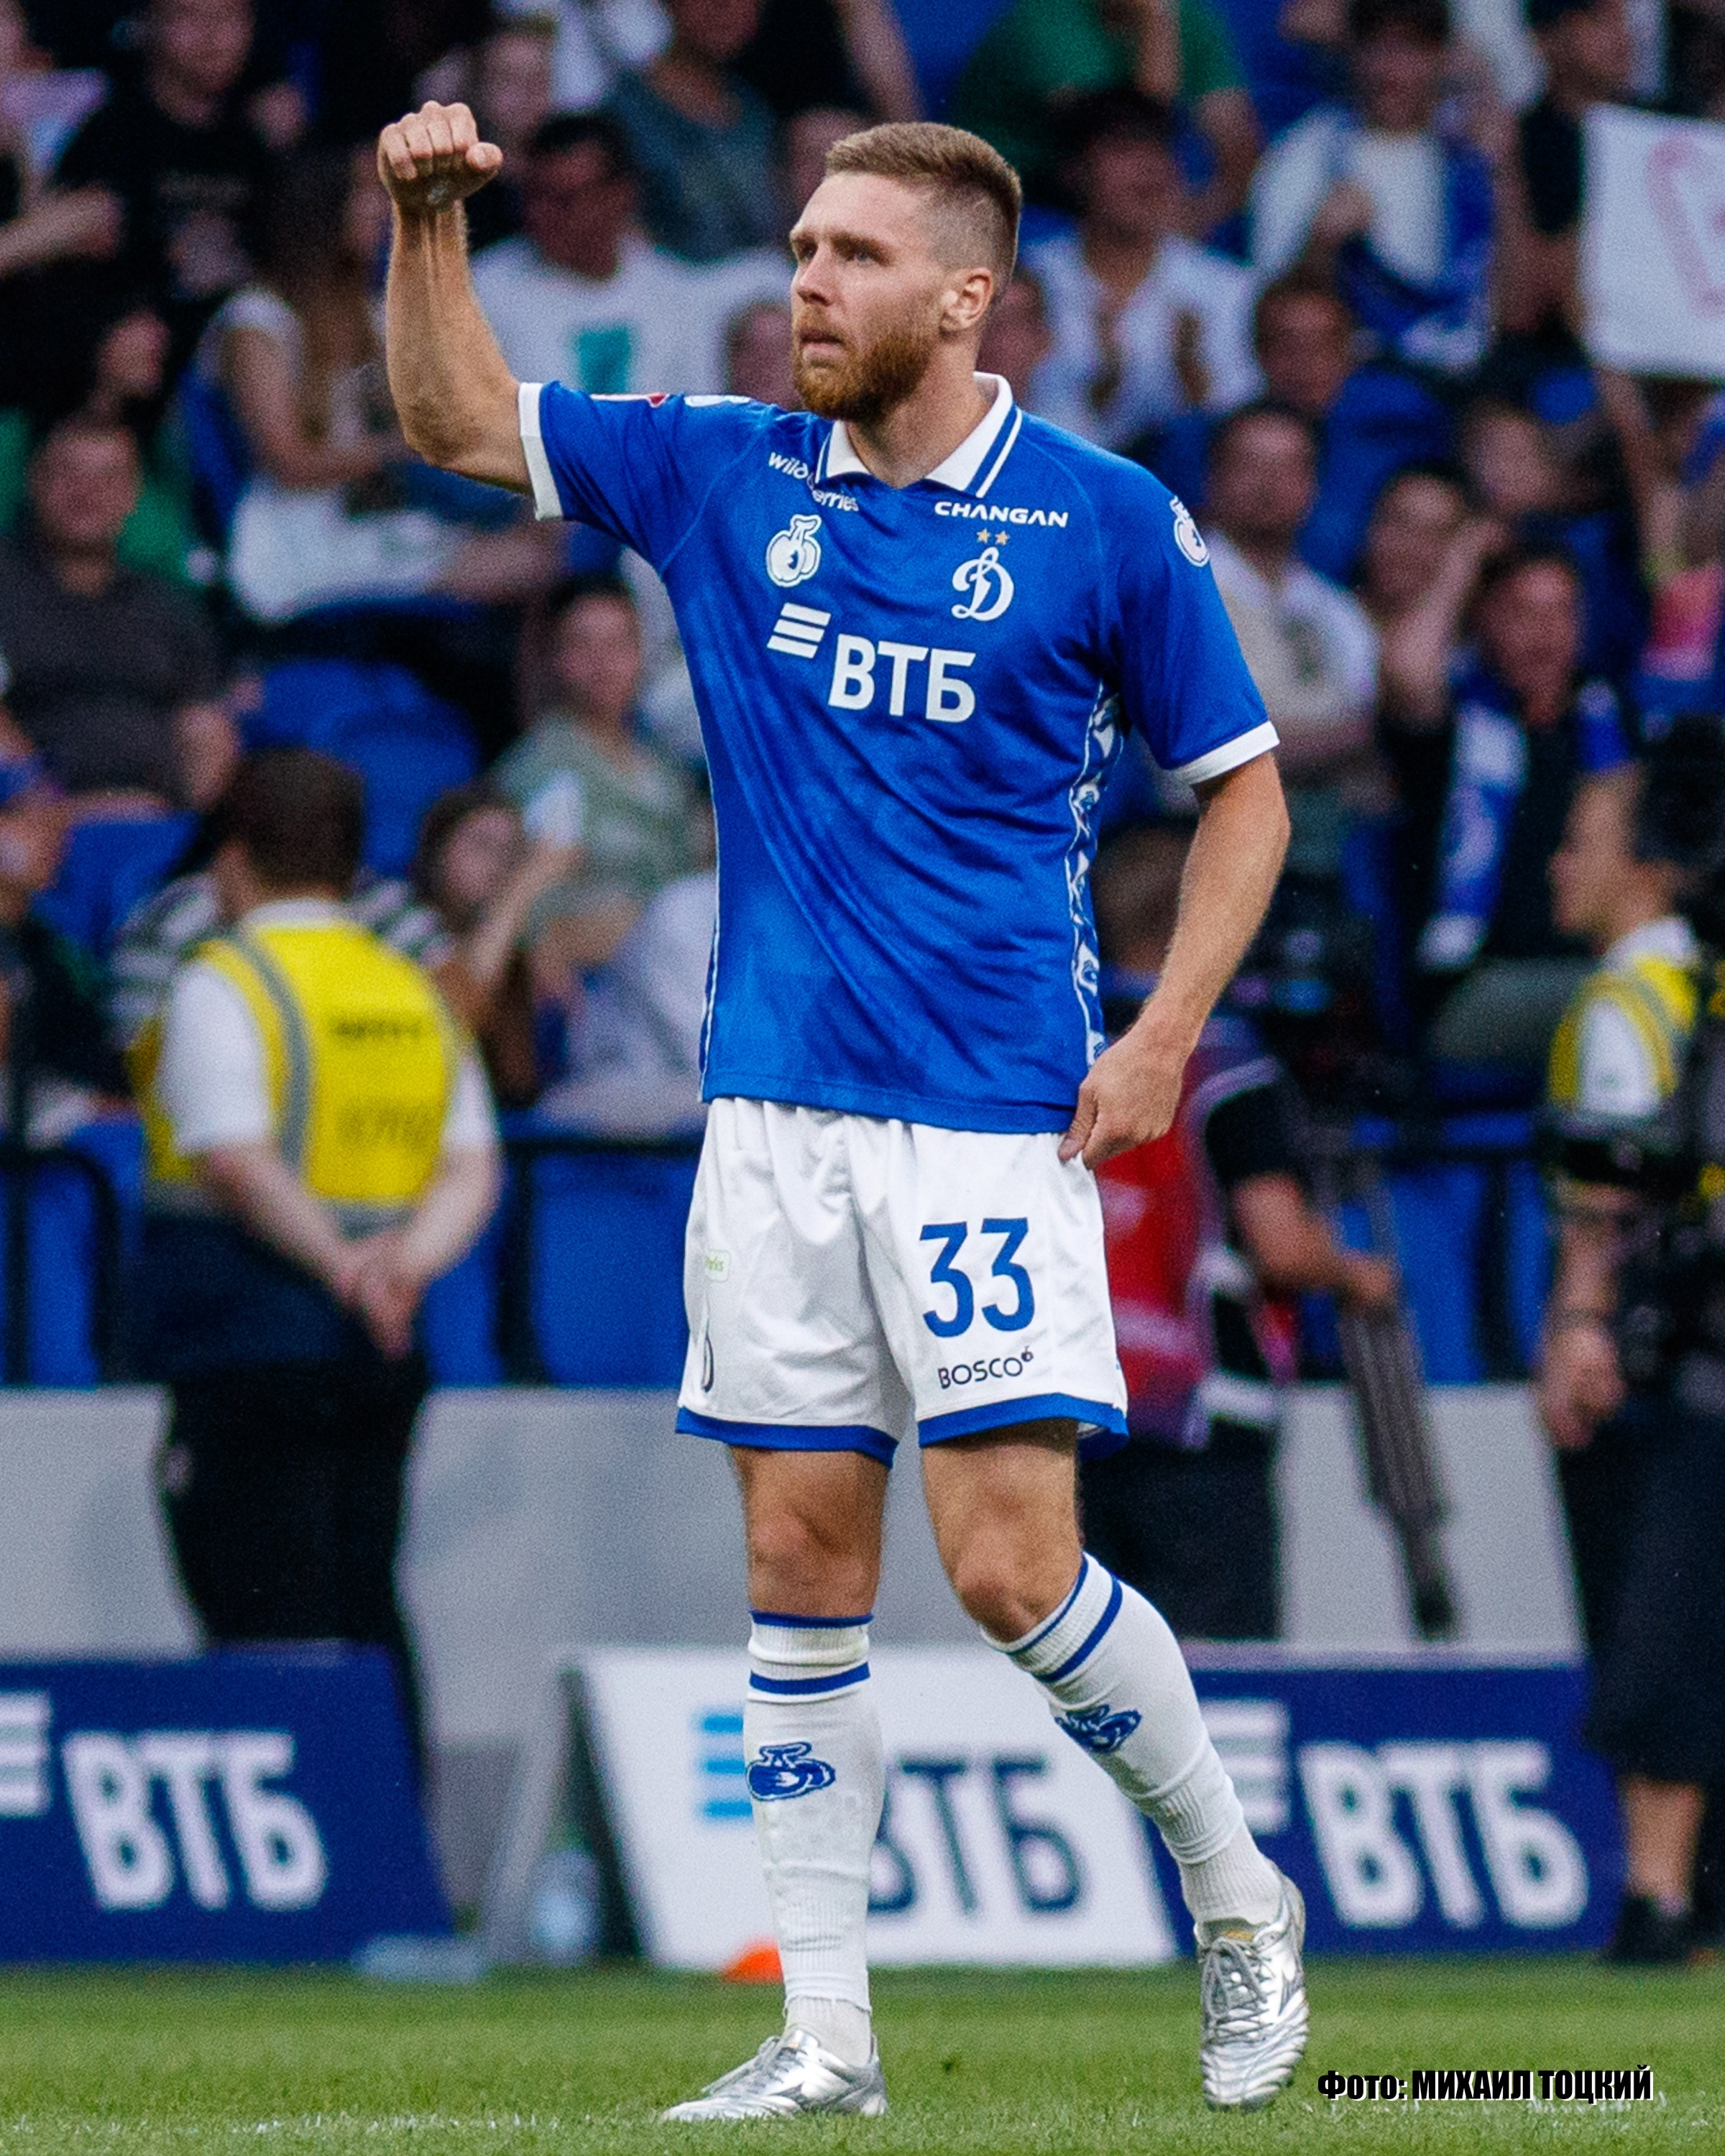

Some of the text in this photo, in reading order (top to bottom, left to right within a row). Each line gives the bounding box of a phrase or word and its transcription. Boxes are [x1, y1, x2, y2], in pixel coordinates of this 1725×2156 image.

[934, 502, 1069, 528] CHANGAN
[827, 633, 976, 723] ВТБ
[919, 1217, 1035, 1337] 33
[937, 1357, 1023, 1389] BOSCO
[62, 1729, 328, 1912] ВТБ
[1300, 1741, 1588, 1928] ВТБ
